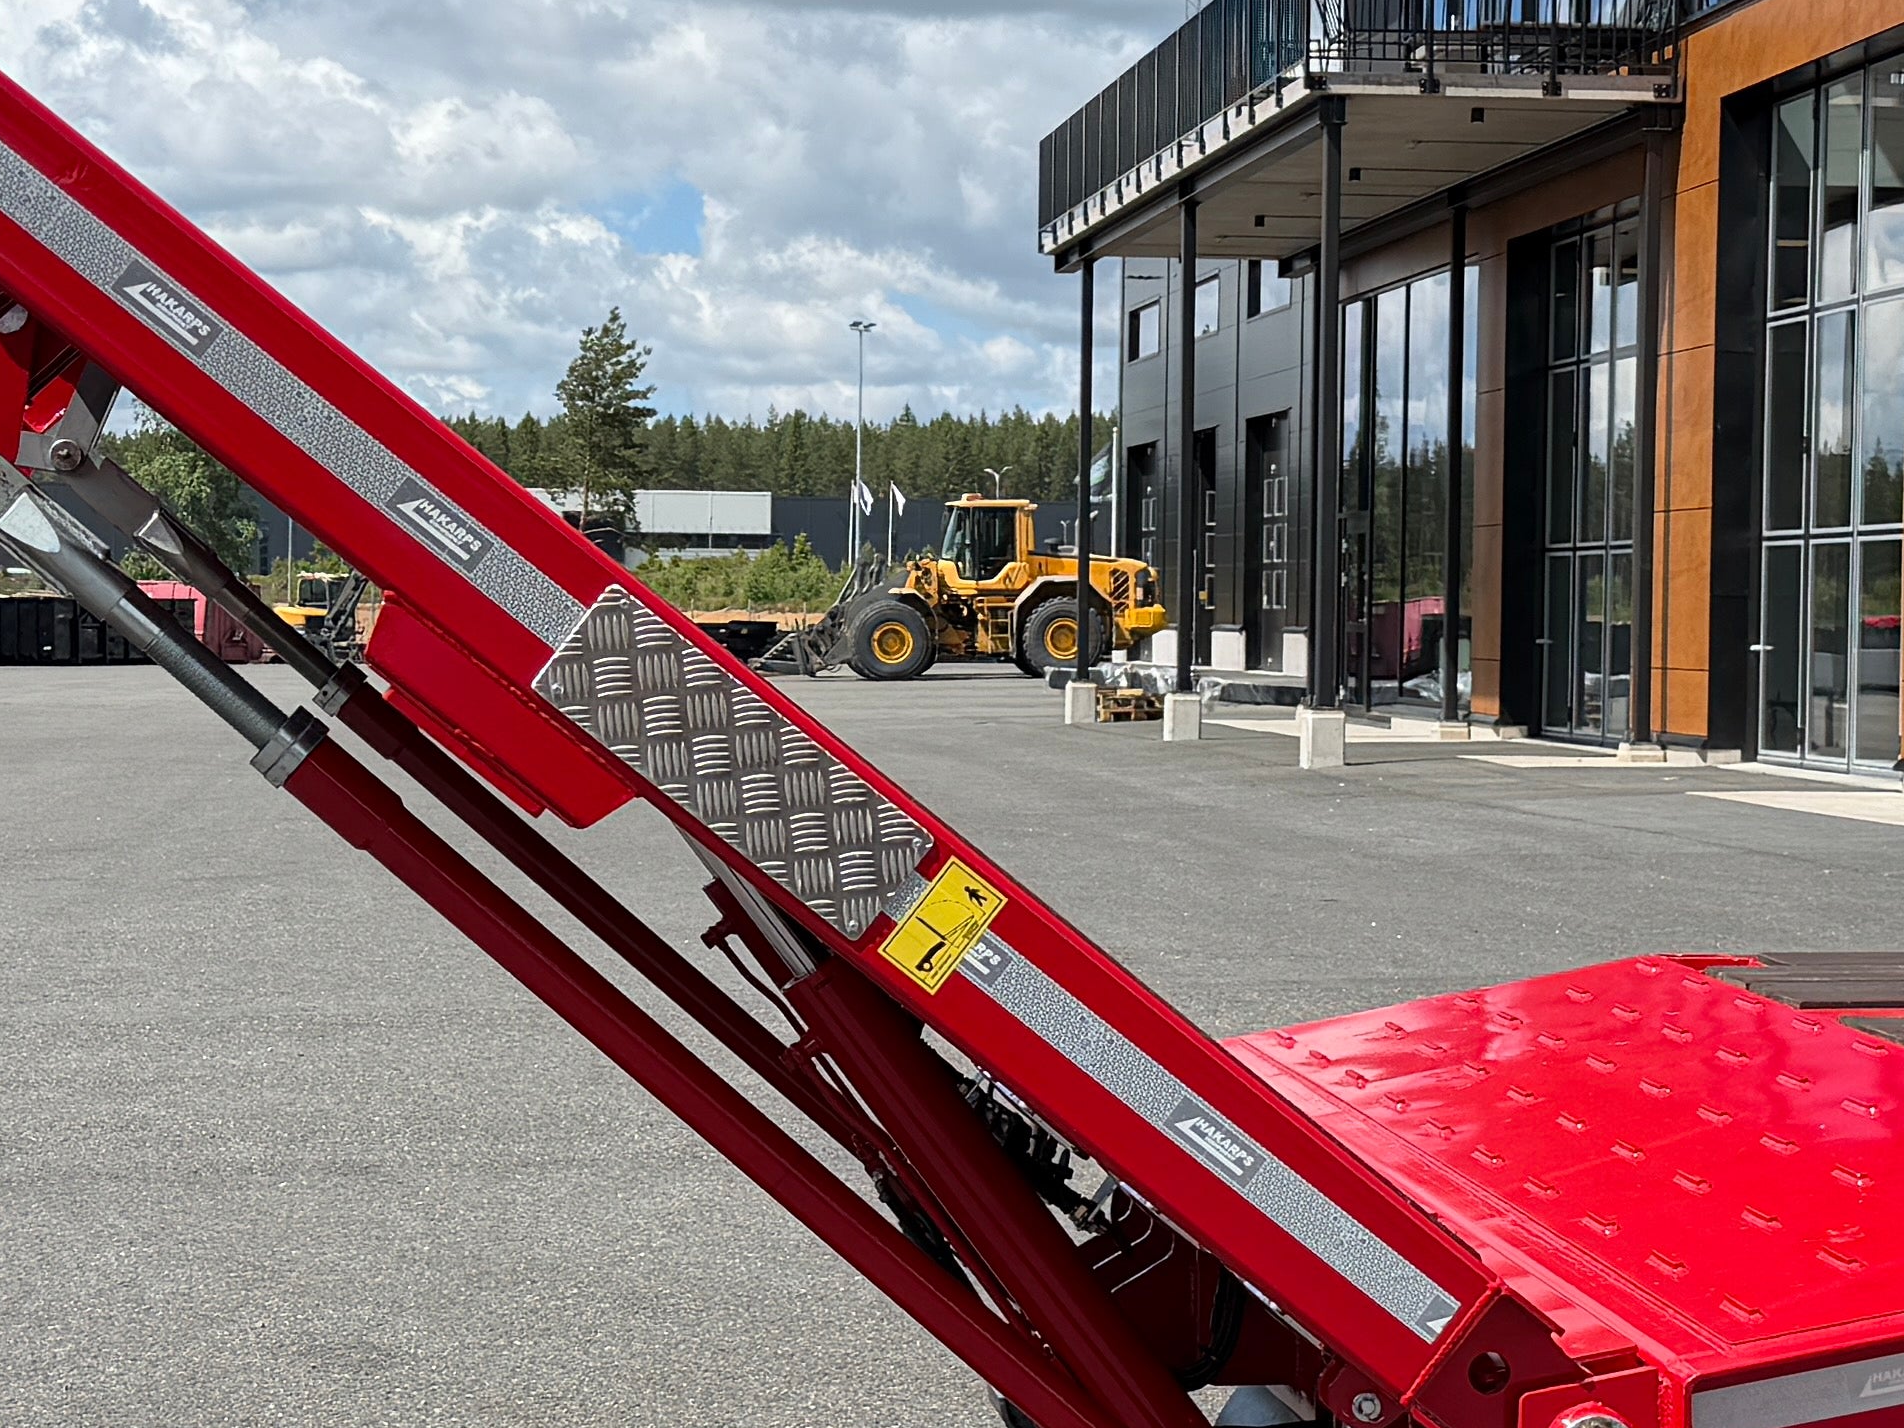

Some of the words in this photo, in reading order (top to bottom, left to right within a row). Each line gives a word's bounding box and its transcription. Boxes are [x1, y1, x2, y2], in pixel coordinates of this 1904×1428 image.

[145, 283, 211, 336] HAKARPS
[419, 500, 482, 552] HAKARPS
[1196, 1118, 1255, 1167] HAKARPS
